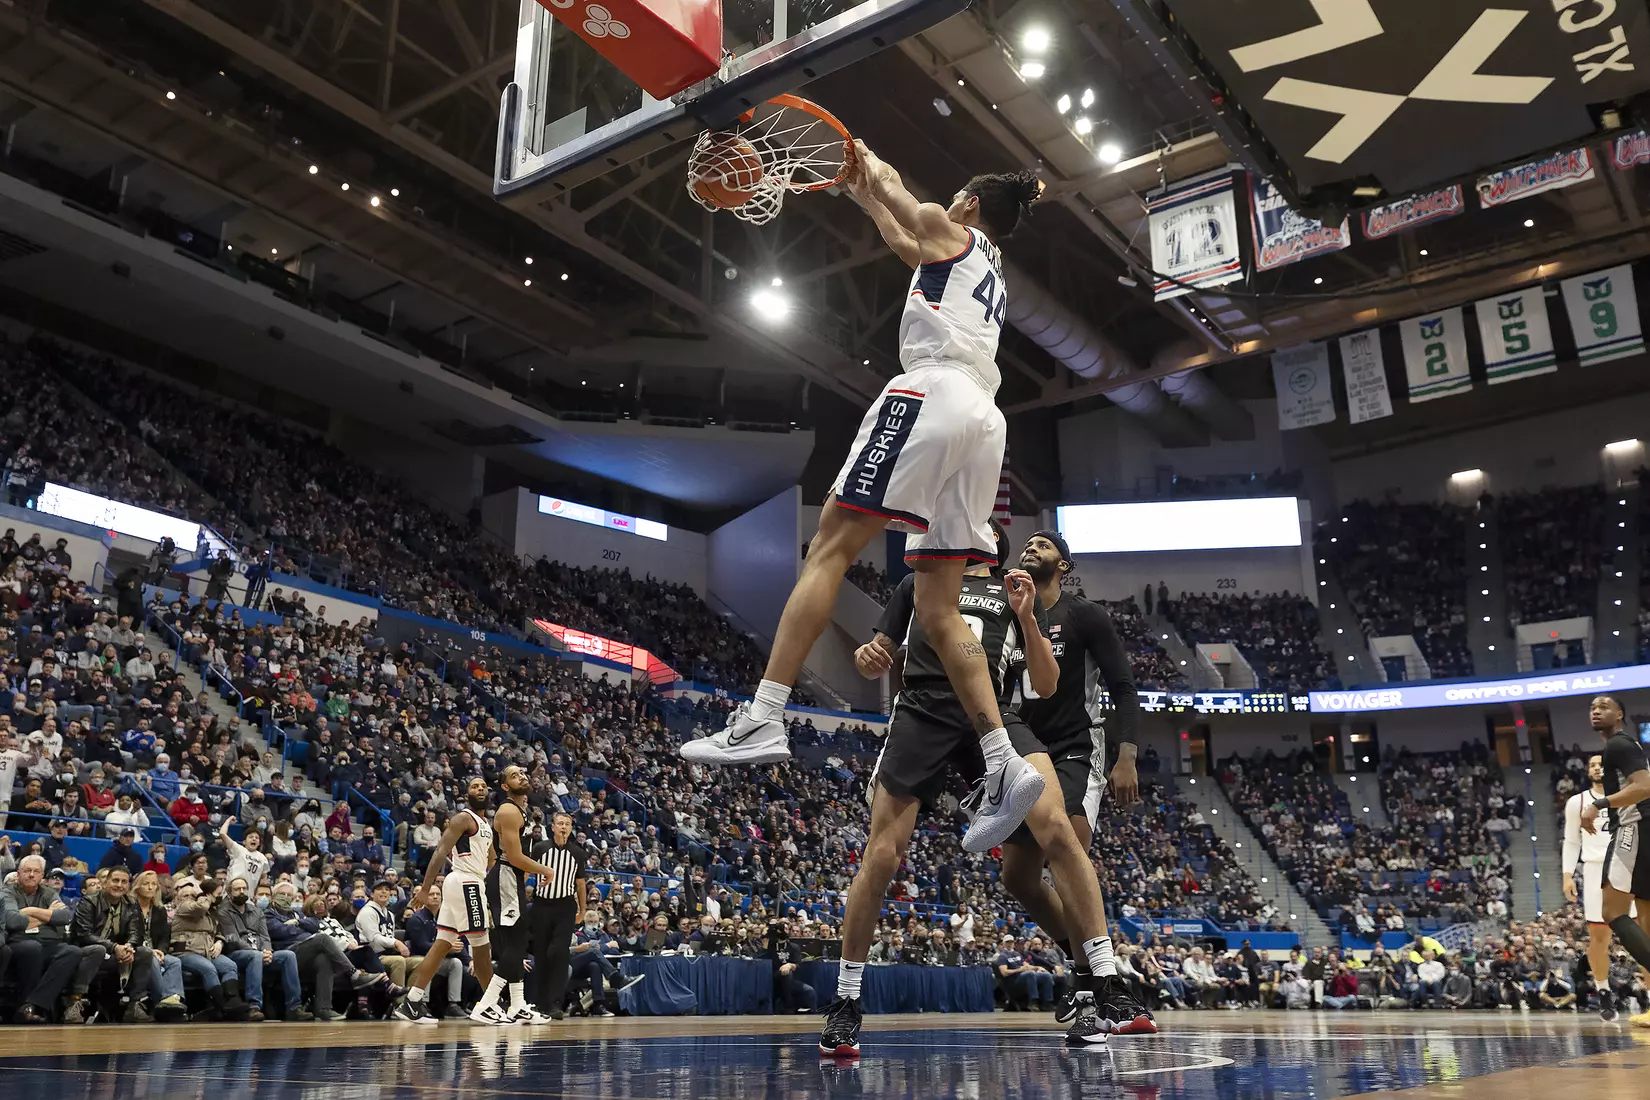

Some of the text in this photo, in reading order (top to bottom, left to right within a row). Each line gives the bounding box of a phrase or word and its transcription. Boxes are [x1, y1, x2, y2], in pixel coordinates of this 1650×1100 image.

[1572, 25, 1635, 84] XL
[1166, 218, 1224, 269] 12
[1590, 301, 1618, 338] 9
[1502, 320, 1531, 355] 5
[1425, 342, 1449, 377] 2
[856, 401, 908, 496] HUSKIES
[602, 549, 621, 562] 207
[234, 561, 249, 575] 10
[1063, 576, 1081, 587] 232
[1216, 578, 1237, 589] 233
[470, 629, 486, 642] 105
[1317, 690, 1403, 710] VOYAGER
[1445, 684, 1524, 701] CRYPTO
[1527, 680, 1567, 694] FOR
[247, 861, 258, 875] 30
[467, 886, 482, 928] HUSKIES
